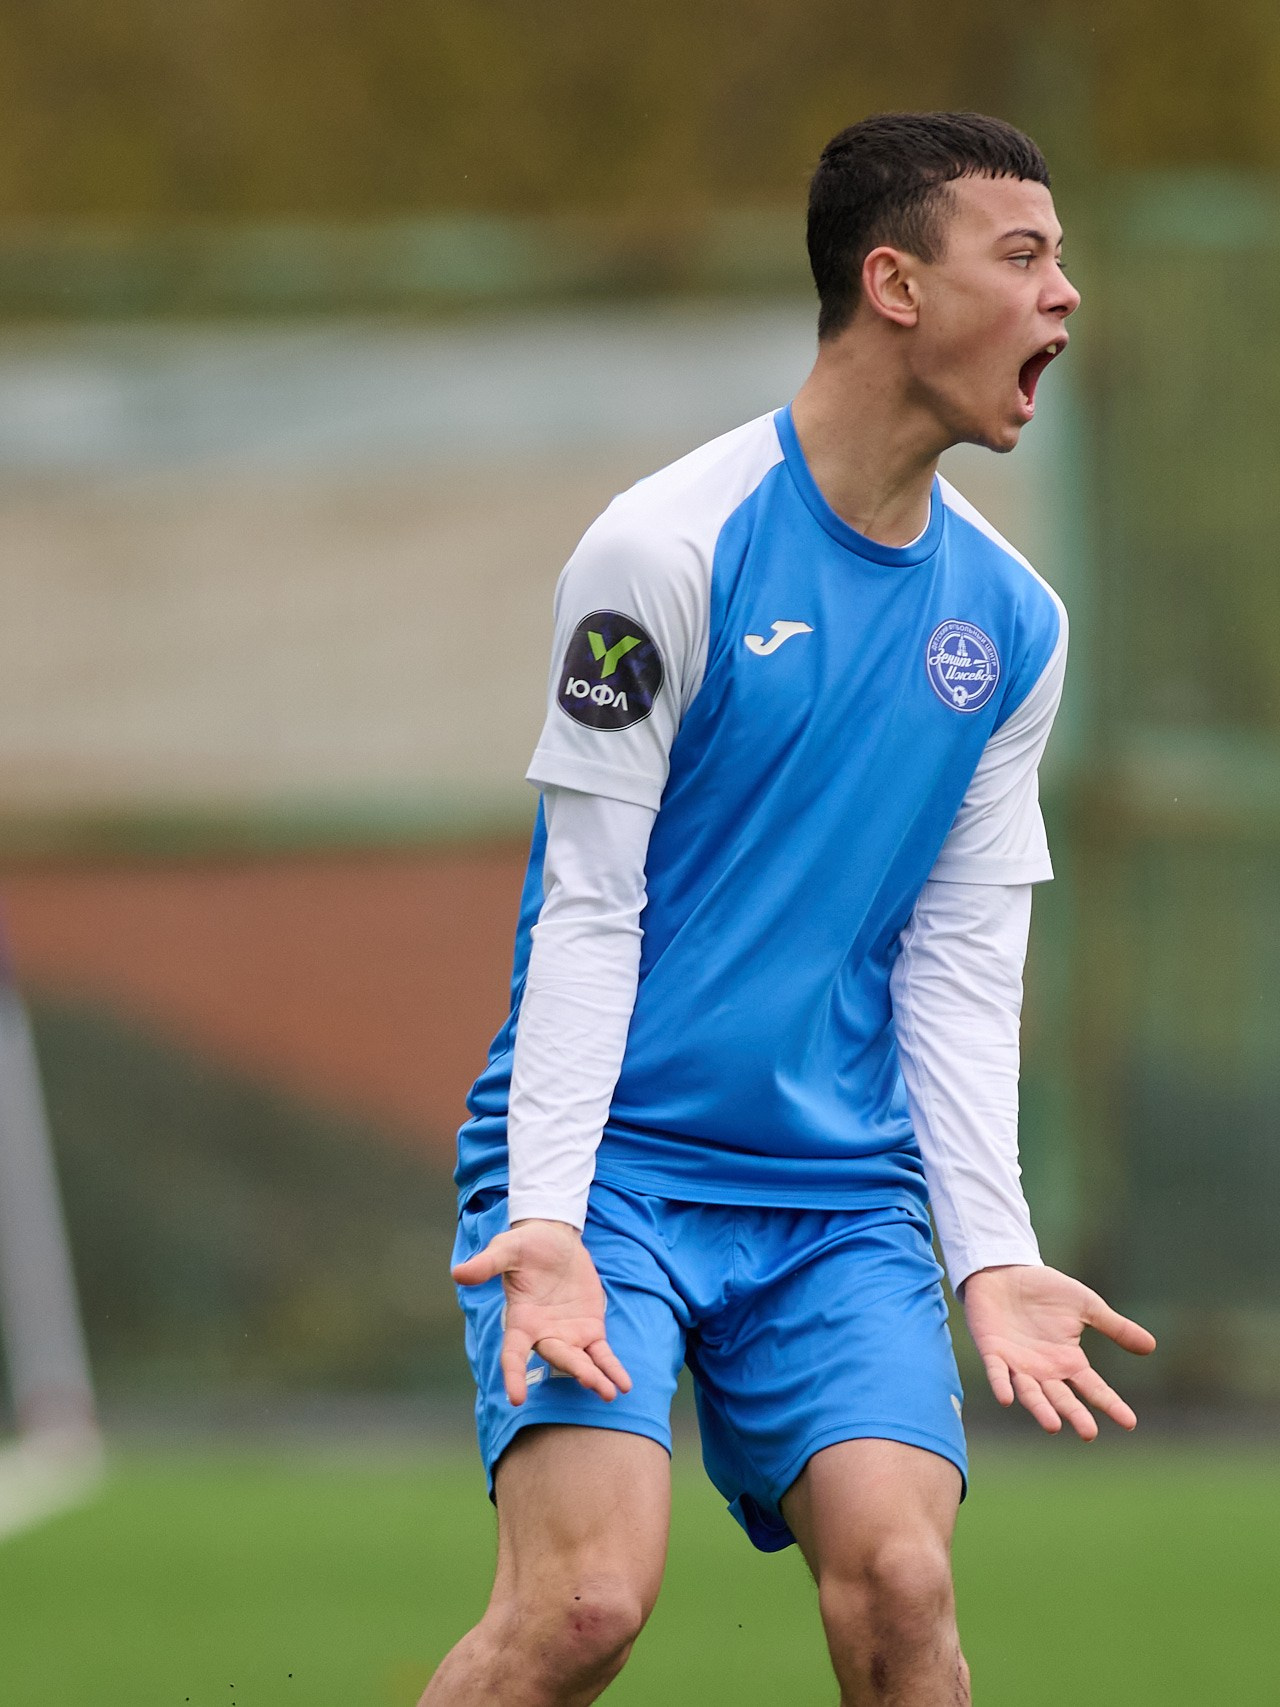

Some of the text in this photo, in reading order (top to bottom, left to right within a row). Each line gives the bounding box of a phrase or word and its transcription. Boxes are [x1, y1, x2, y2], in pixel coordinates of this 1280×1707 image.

[929, 647, 973, 668] Зенит
[945, 665, 997, 681] Ижевск
[564, 676, 629, 712] ЮФЛ
